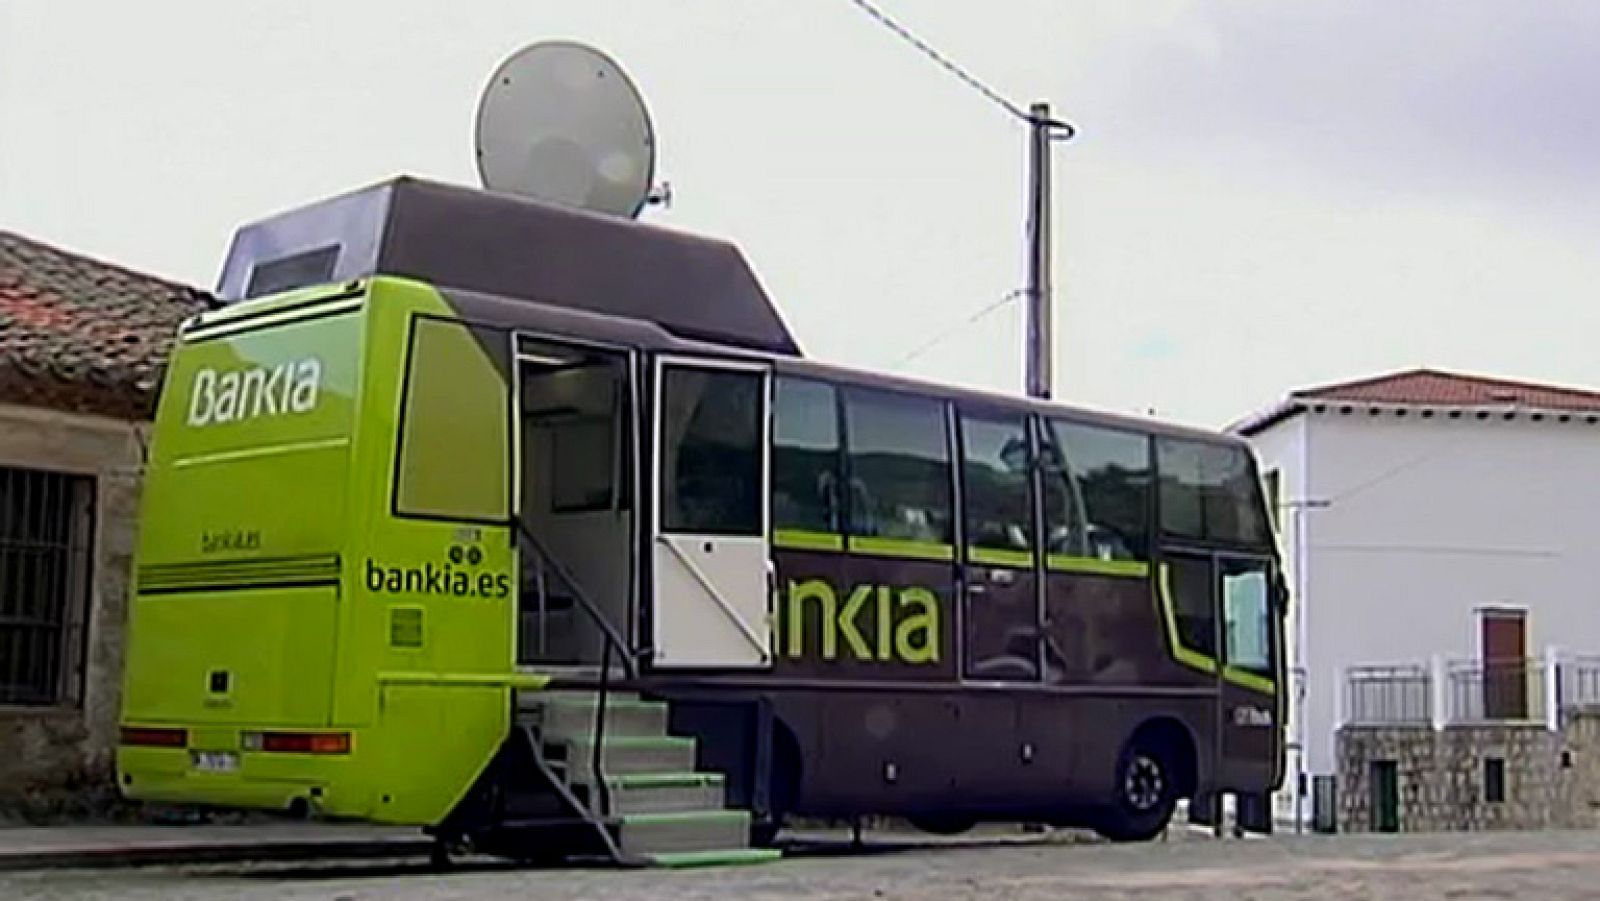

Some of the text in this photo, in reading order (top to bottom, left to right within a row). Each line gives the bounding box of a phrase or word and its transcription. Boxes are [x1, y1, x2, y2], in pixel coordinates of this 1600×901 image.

[188, 358, 321, 426] Bankia
[367, 557, 510, 598] bankia.es
[775, 579, 940, 664] nkia
